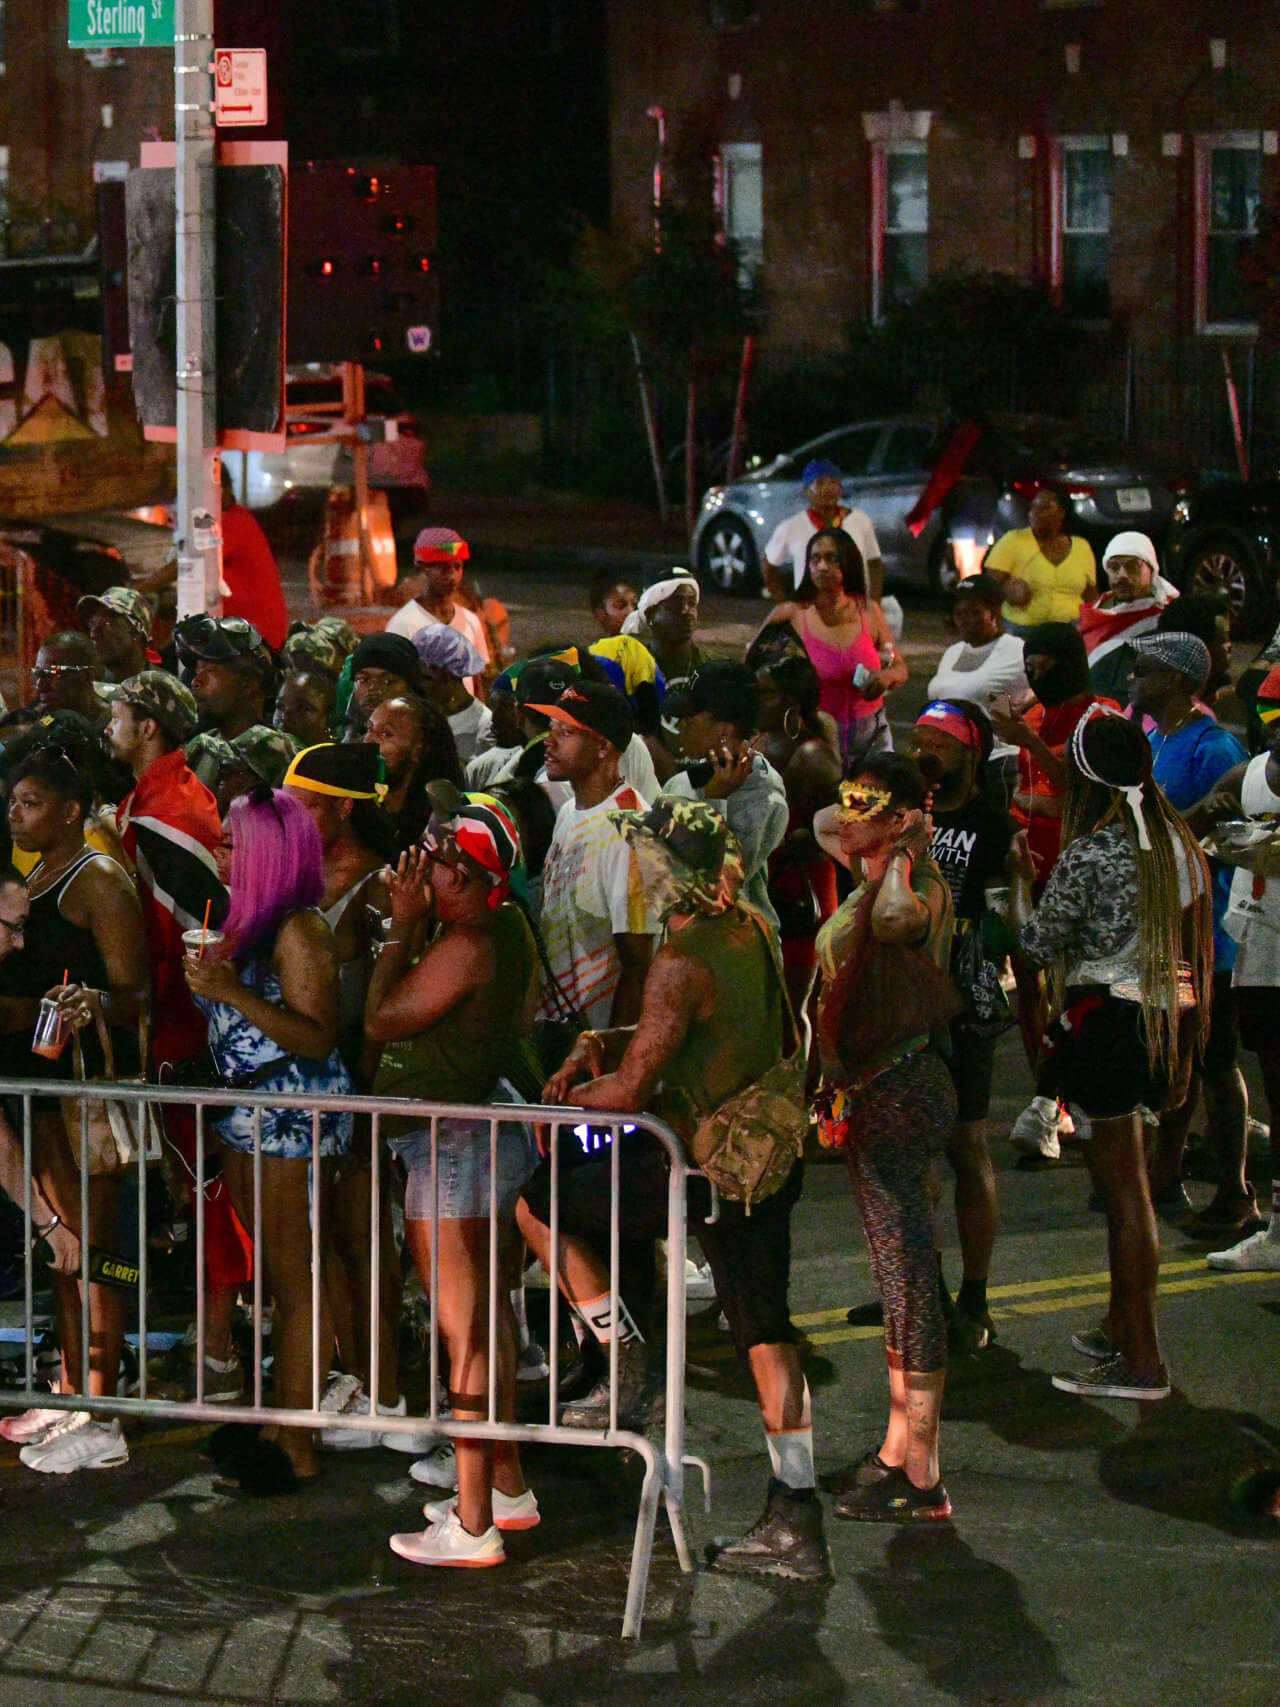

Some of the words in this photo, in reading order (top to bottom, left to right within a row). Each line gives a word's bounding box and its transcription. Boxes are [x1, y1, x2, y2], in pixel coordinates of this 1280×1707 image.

[87, 0, 145, 46] Sterling
[151, 0, 162, 19] St
[929, 826, 977, 853] IAN
[102, 1260, 139, 1284] GARRET
